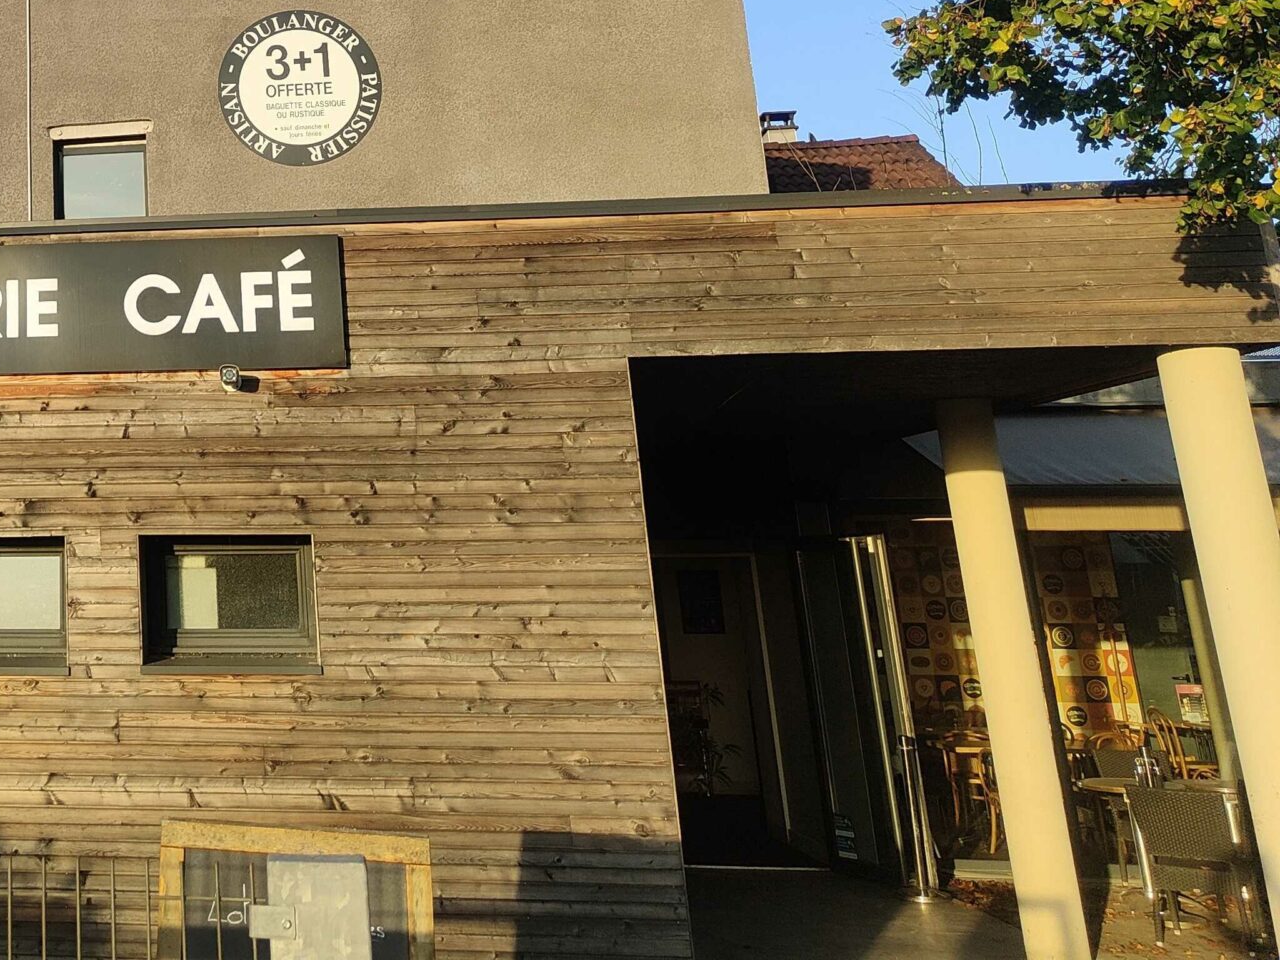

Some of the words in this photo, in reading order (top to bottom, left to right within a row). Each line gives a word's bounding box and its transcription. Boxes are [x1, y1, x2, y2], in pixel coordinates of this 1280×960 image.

[265, 42, 331, 81] 3+1
[231, 13, 360, 60] BOULANGER
[307, 71, 378, 162] PATISSIER
[266, 81, 333, 98] OFFERTE
[266, 101, 303, 111] BAGUETTE
[305, 99, 347, 109] CLASSIQUE
[220, 82, 286, 159] ARTISAN
[276, 111, 287, 119] OU
[289, 110, 325, 118] RUSTIQUE
[123, 248, 315, 336] CAFÉ
